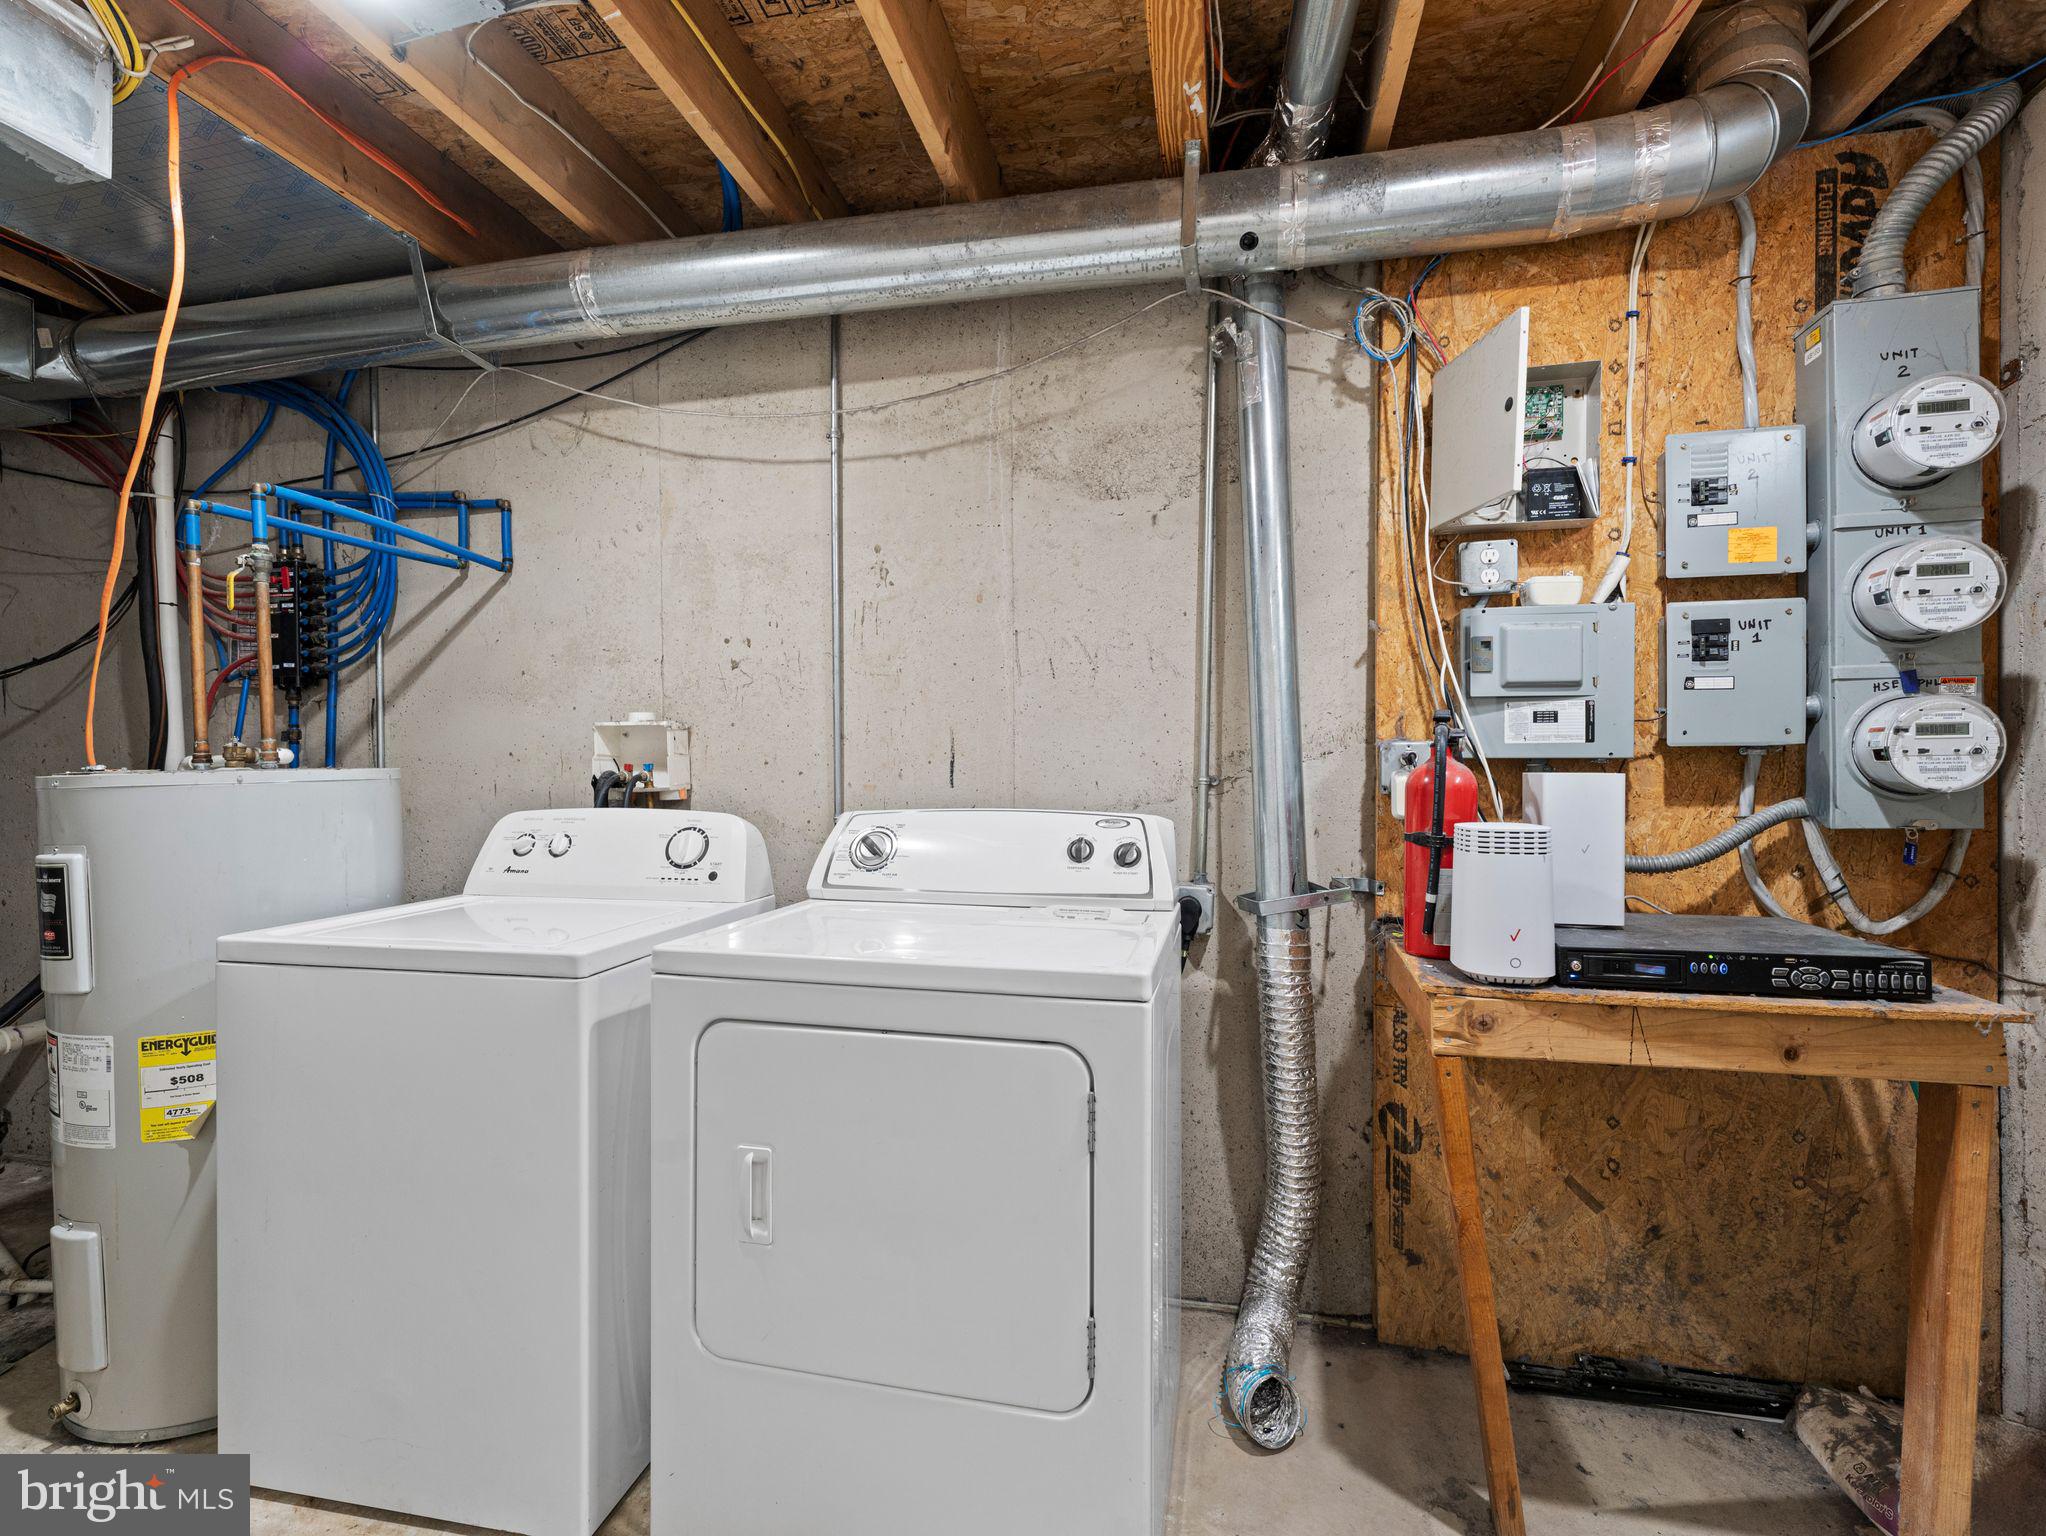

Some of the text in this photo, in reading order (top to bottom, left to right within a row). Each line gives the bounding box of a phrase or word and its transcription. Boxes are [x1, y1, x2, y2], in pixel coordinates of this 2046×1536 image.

[1818, 183, 1833, 256] FLOORING
[1880, 348, 1919, 361] UNIT
[1897, 365, 1911, 378] 2
[1736, 453, 1771, 464] UNIT
[1747, 468, 1759, 480] 2
[1875, 525, 1927, 538] UNIT 1
[1738, 619, 1773, 630] UNIT
[1751, 632, 1762, 643] 1
[1873, 680, 1899, 692] HSE
[503, 865, 529, 874] Amana
[141, 1034, 217, 1055] ENERGYGUID
[1393, 1055, 1408, 1089] TRY
[170, 1073, 205, 1086] $508
[166, 1107, 191, 1116] 4773
